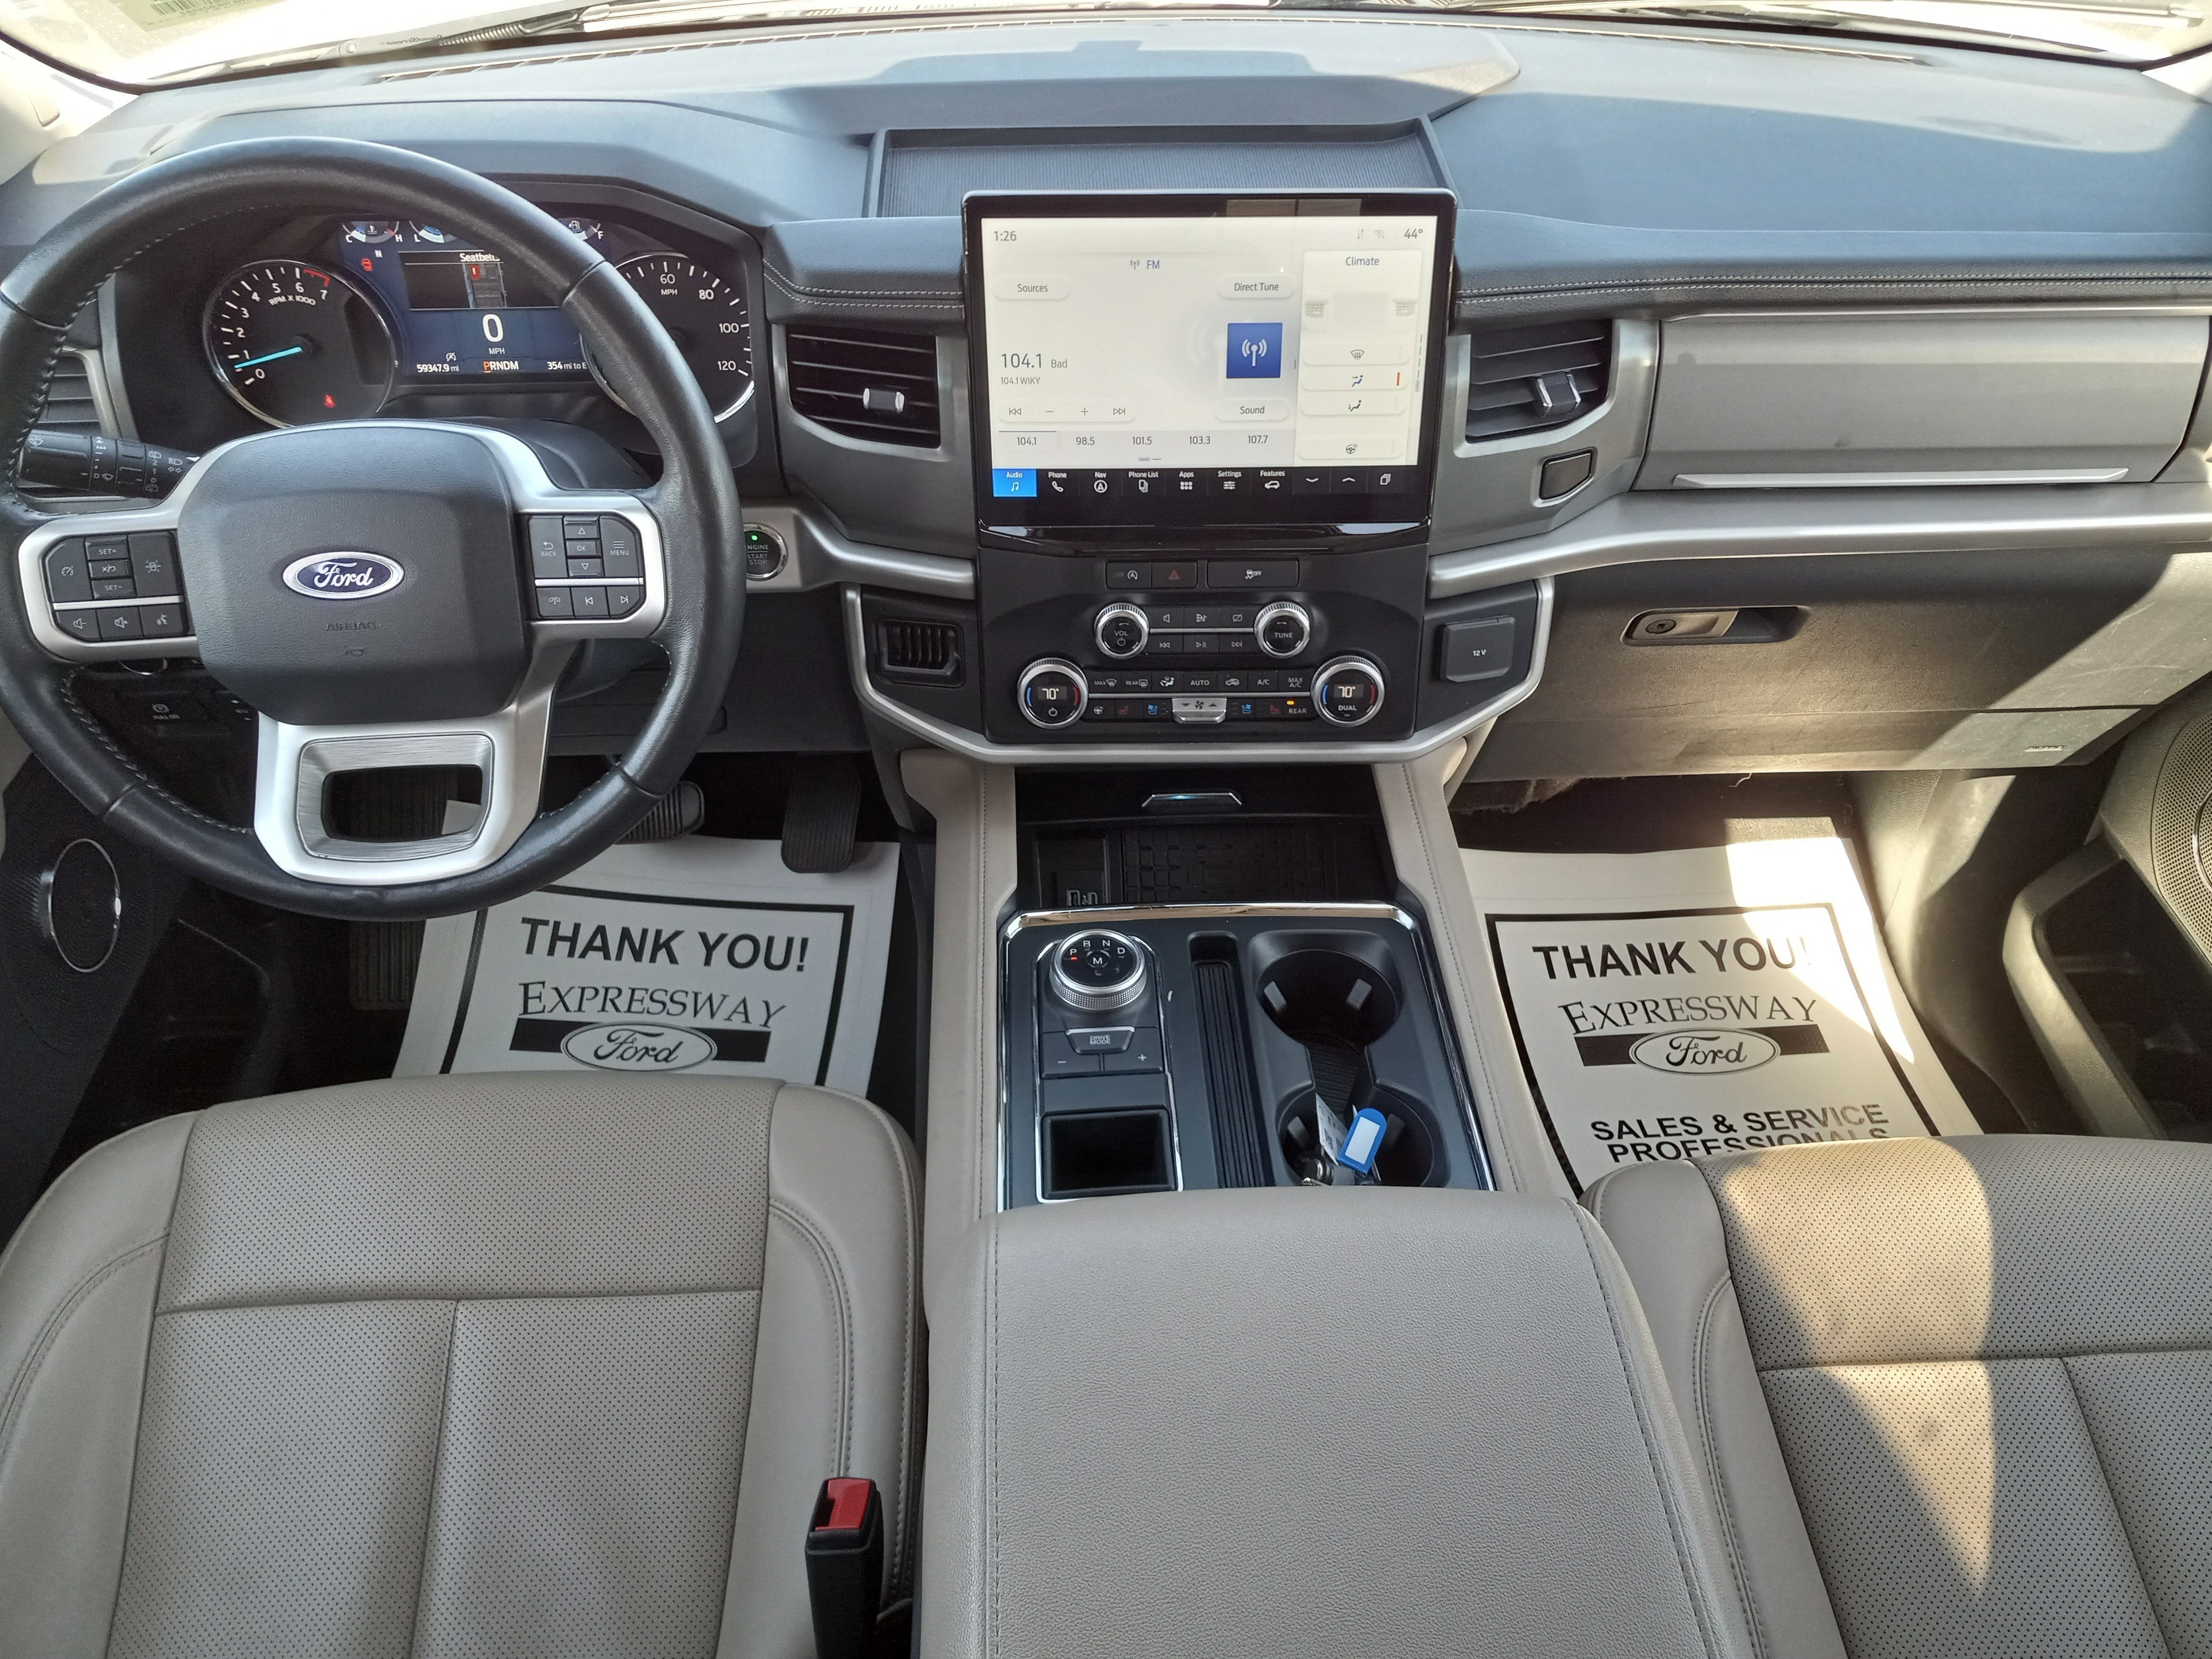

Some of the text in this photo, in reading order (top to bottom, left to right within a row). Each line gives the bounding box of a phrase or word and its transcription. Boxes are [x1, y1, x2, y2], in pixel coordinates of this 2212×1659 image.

[396, 234, 403, 242] H
[414, 234, 421, 242] L
[598, 231, 604, 240] F
[994, 230, 1016, 241] 1:26
[1404, 228, 1423, 239] 44°
[346, 235, 352, 243] C
[374, 250, 383, 258] N
[1146, 260, 1160, 269] FM
[1346, 256, 1379, 266] Climate
[660, 274, 675, 284] 60
[272, 283, 281, 293] 5
[295, 282, 304, 293] 6
[1017, 284, 1048, 292] Sources
[1234, 283, 1279, 291] Direct Tune
[252, 292, 261, 302] 4
[320, 289, 327, 300] 7
[699, 289, 714, 300] 80
[268, 295, 287, 306] RPM
[295, 295, 316, 305] 1000
[240, 308, 249, 318] 3
[236, 327, 246, 338] 2
[482, 314, 503, 342] 0
[719, 323, 739, 333] 100
[243, 350, 250, 359] 1
[547, 361, 563, 370] 354
[1001, 353, 1068, 368] 104.1 Bad
[417, 364, 449, 373] 59347.9
[483, 361, 519, 371] PRNDM
[718, 361, 736, 371] 120
[255, 369, 265, 379] 0
[1017, 437, 1037, 445] 104.1
[1076, 437, 1094, 445] 98.5
[1132, 436, 1152, 445] 101.5
[1189, 436, 1210, 445] 103.3
[1248, 435, 1268, 444] 107.7
[1179, 471, 1194, 479] Apps
[314, 562, 373, 587] Ford
[325, 622, 376, 631] AIRBAG
[1042, 688, 1059, 700] 70°
[1338, 686, 1356, 698] 70°
[520, 916, 809, 972] THANK YOU!
[1532, 936, 1812, 979] THANK YOU!
[518, 980, 786, 1029] EXPRESSWAY
[1558, 995, 1816, 1035] EXPRESSWAY
[594, 1028, 684, 1064] Ford
[1665, 1035, 1747, 1067] Ford
[1591, 1104, 1889, 1141] SALES & SERVICE
